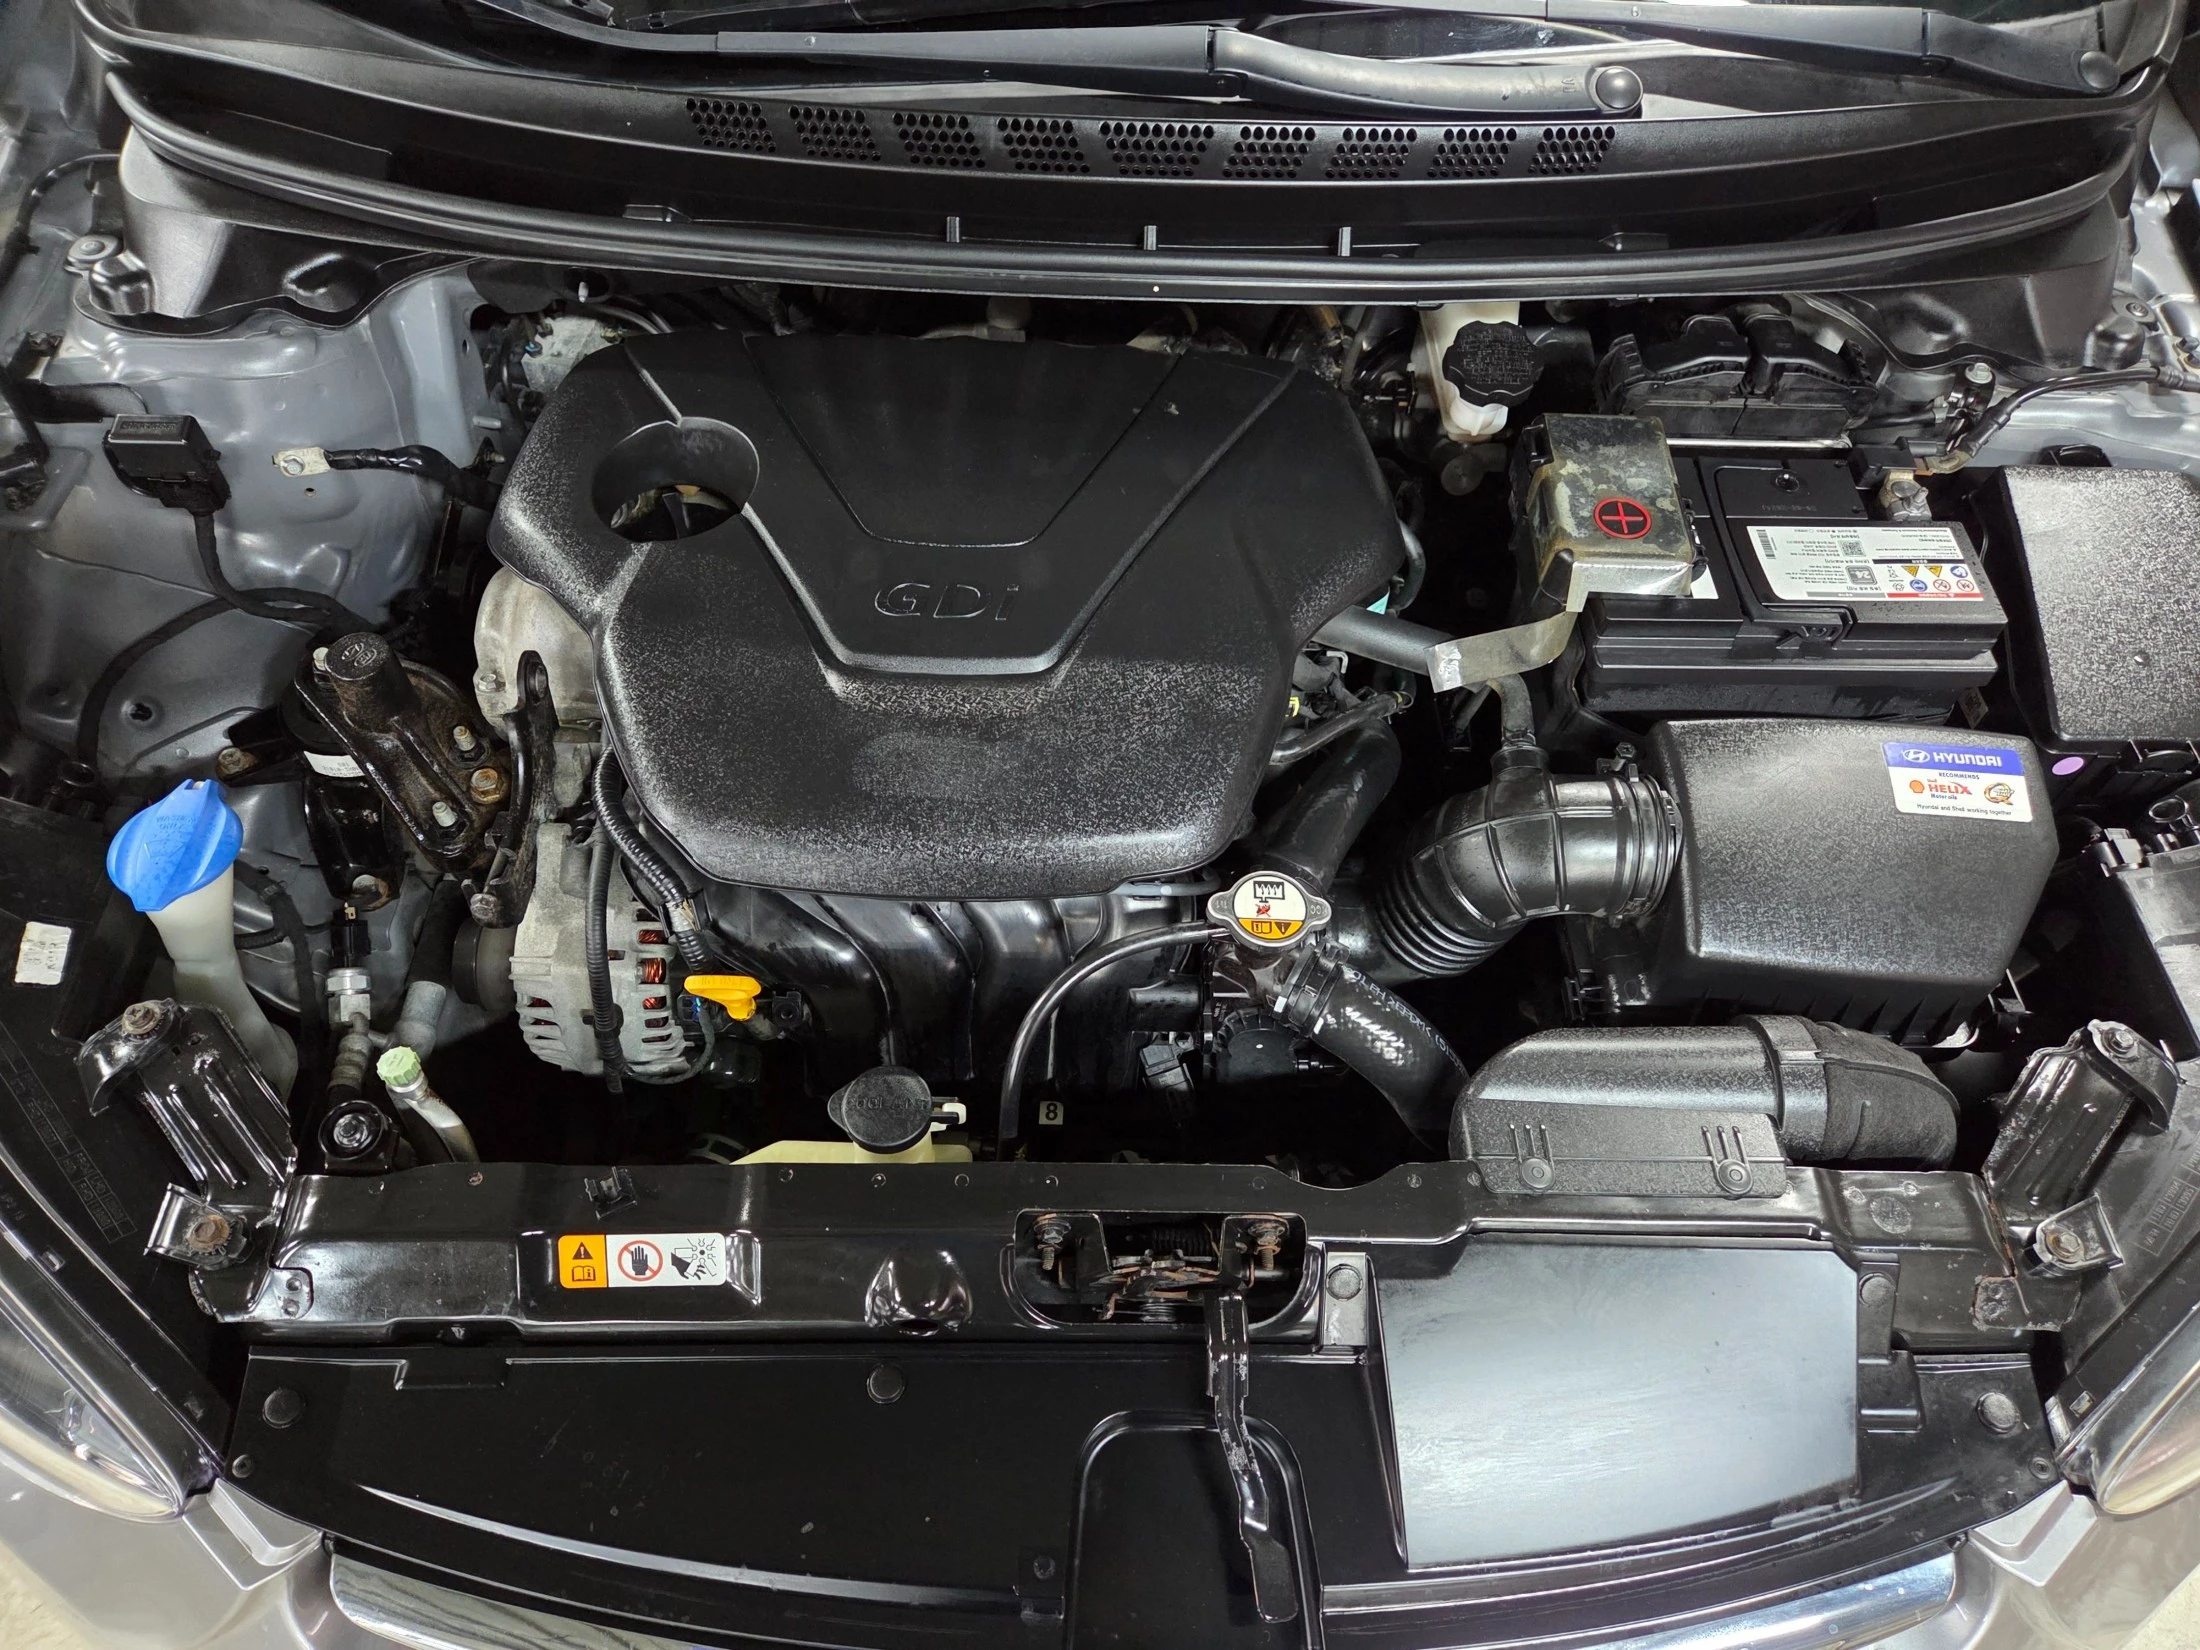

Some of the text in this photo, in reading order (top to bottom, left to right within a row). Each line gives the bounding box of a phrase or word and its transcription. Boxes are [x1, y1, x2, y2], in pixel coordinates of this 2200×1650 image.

[1933, 752, 2003, 768] HYUNDAI
[1938, 772, 1980, 781] RECOMMENDS
[1928, 782, 1973, 795] HELIX
[1916, 803, 1940, 811] Hyundai
[1966, 807, 1988, 816] working
[1045, 1102, 1059, 1121] 8
